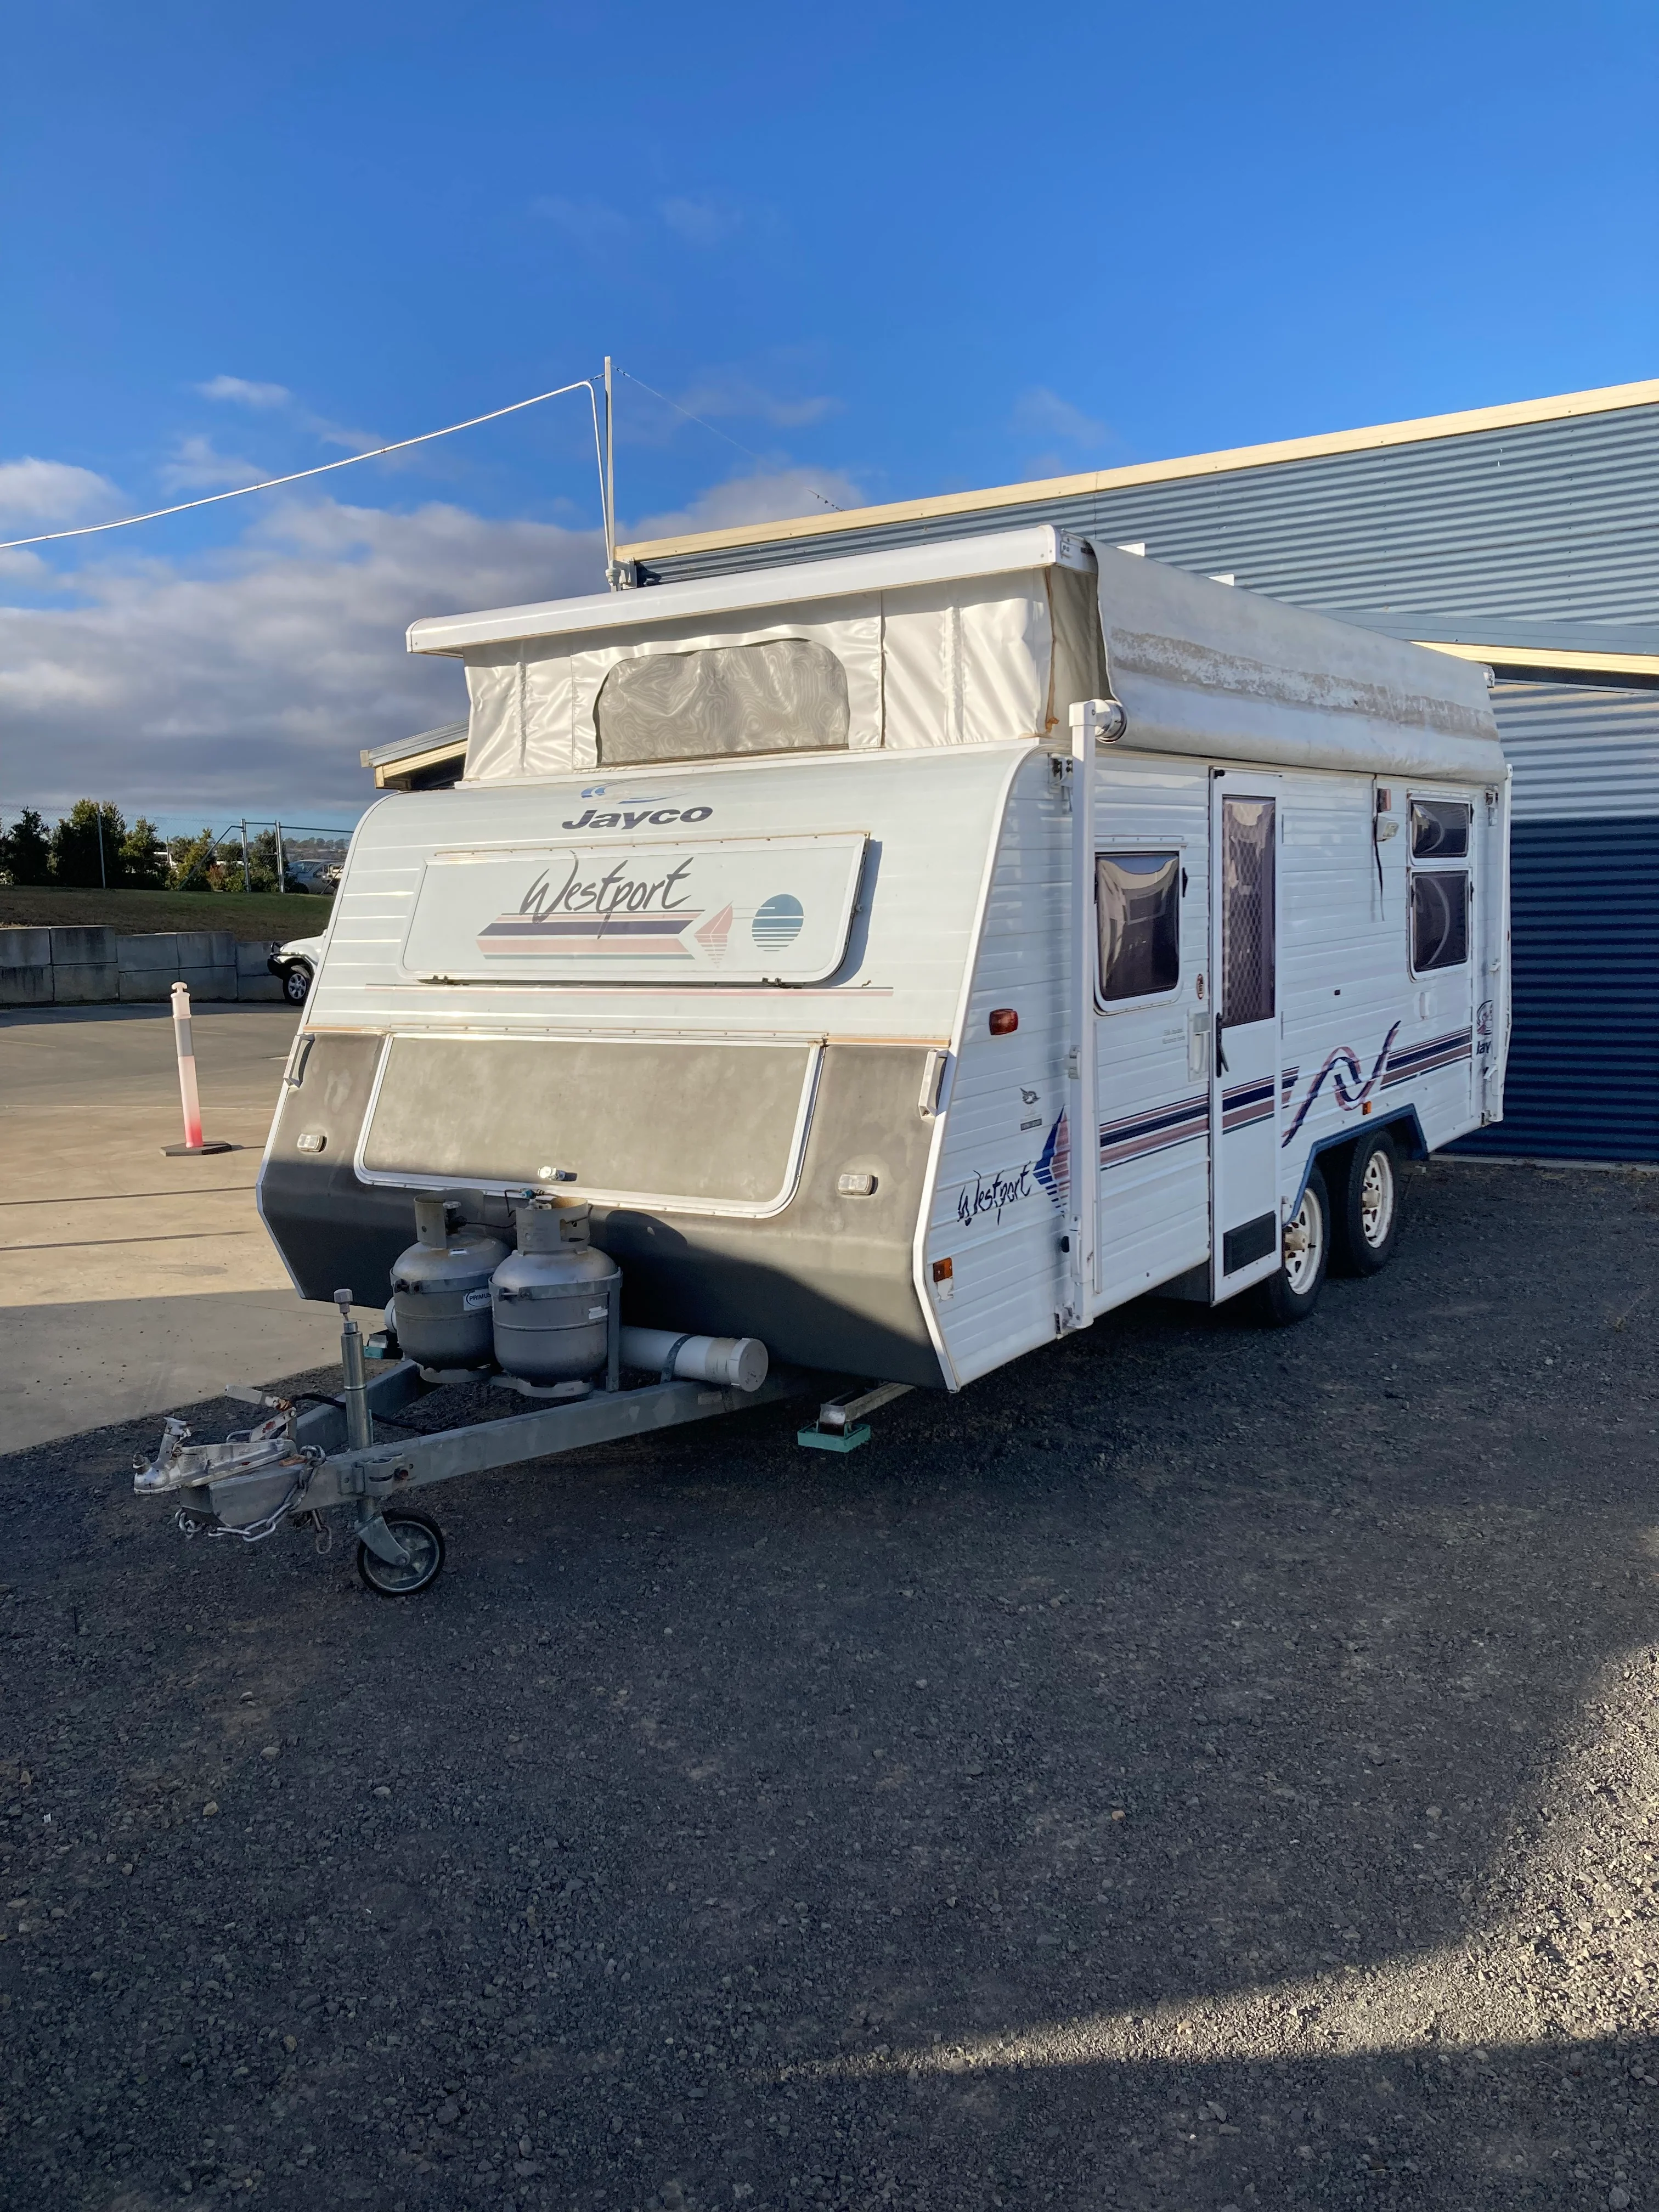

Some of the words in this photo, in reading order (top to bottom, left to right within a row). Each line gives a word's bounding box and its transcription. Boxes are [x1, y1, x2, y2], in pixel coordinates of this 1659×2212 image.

[562, 806, 713, 830] Jayco
[519, 850, 694, 940] Westport
[1476, 1041, 1492, 1054] Jay
[957, 1160, 1032, 1227] Westport
[469, 1293, 492, 1301] PRIMUS
